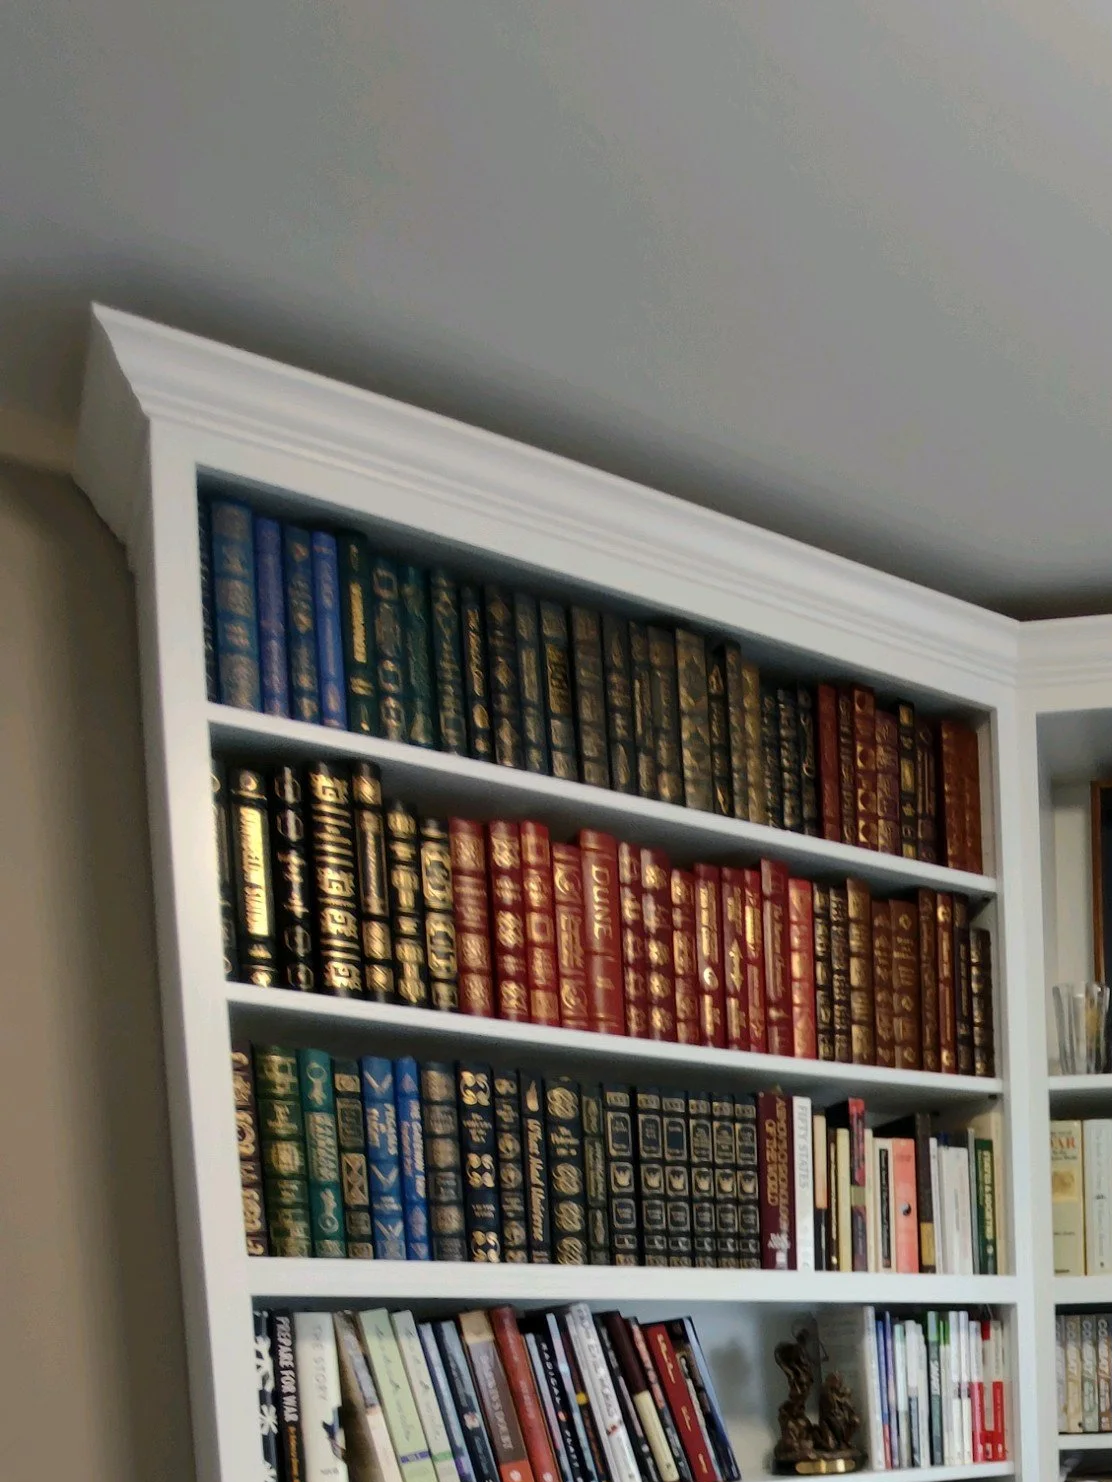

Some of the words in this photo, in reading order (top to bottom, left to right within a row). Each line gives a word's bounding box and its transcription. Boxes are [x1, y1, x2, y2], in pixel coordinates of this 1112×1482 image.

[590, 864, 613, 940] DUNE
[526, 1117, 543, 1154] What
[797, 1103, 810, 1141] FIFTY
[528, 1154, 545, 1187] Mad
[766, 1163, 779, 1205] WORLD
[797, 1143, 810, 1189] STATES
[530, 1187, 547, 1242] Universe
[277, 1315, 295, 1369] PREPARE
[312, 1324, 325, 1350] THE
[281, 1369, 296, 1394] FOR
[314, 1356, 329, 1402] STORY
[283, 1394, 299, 1422] WAR
[540, 1341, 562, 1404] RADICAL
[564, 1428, 580, 1467] PLATT
